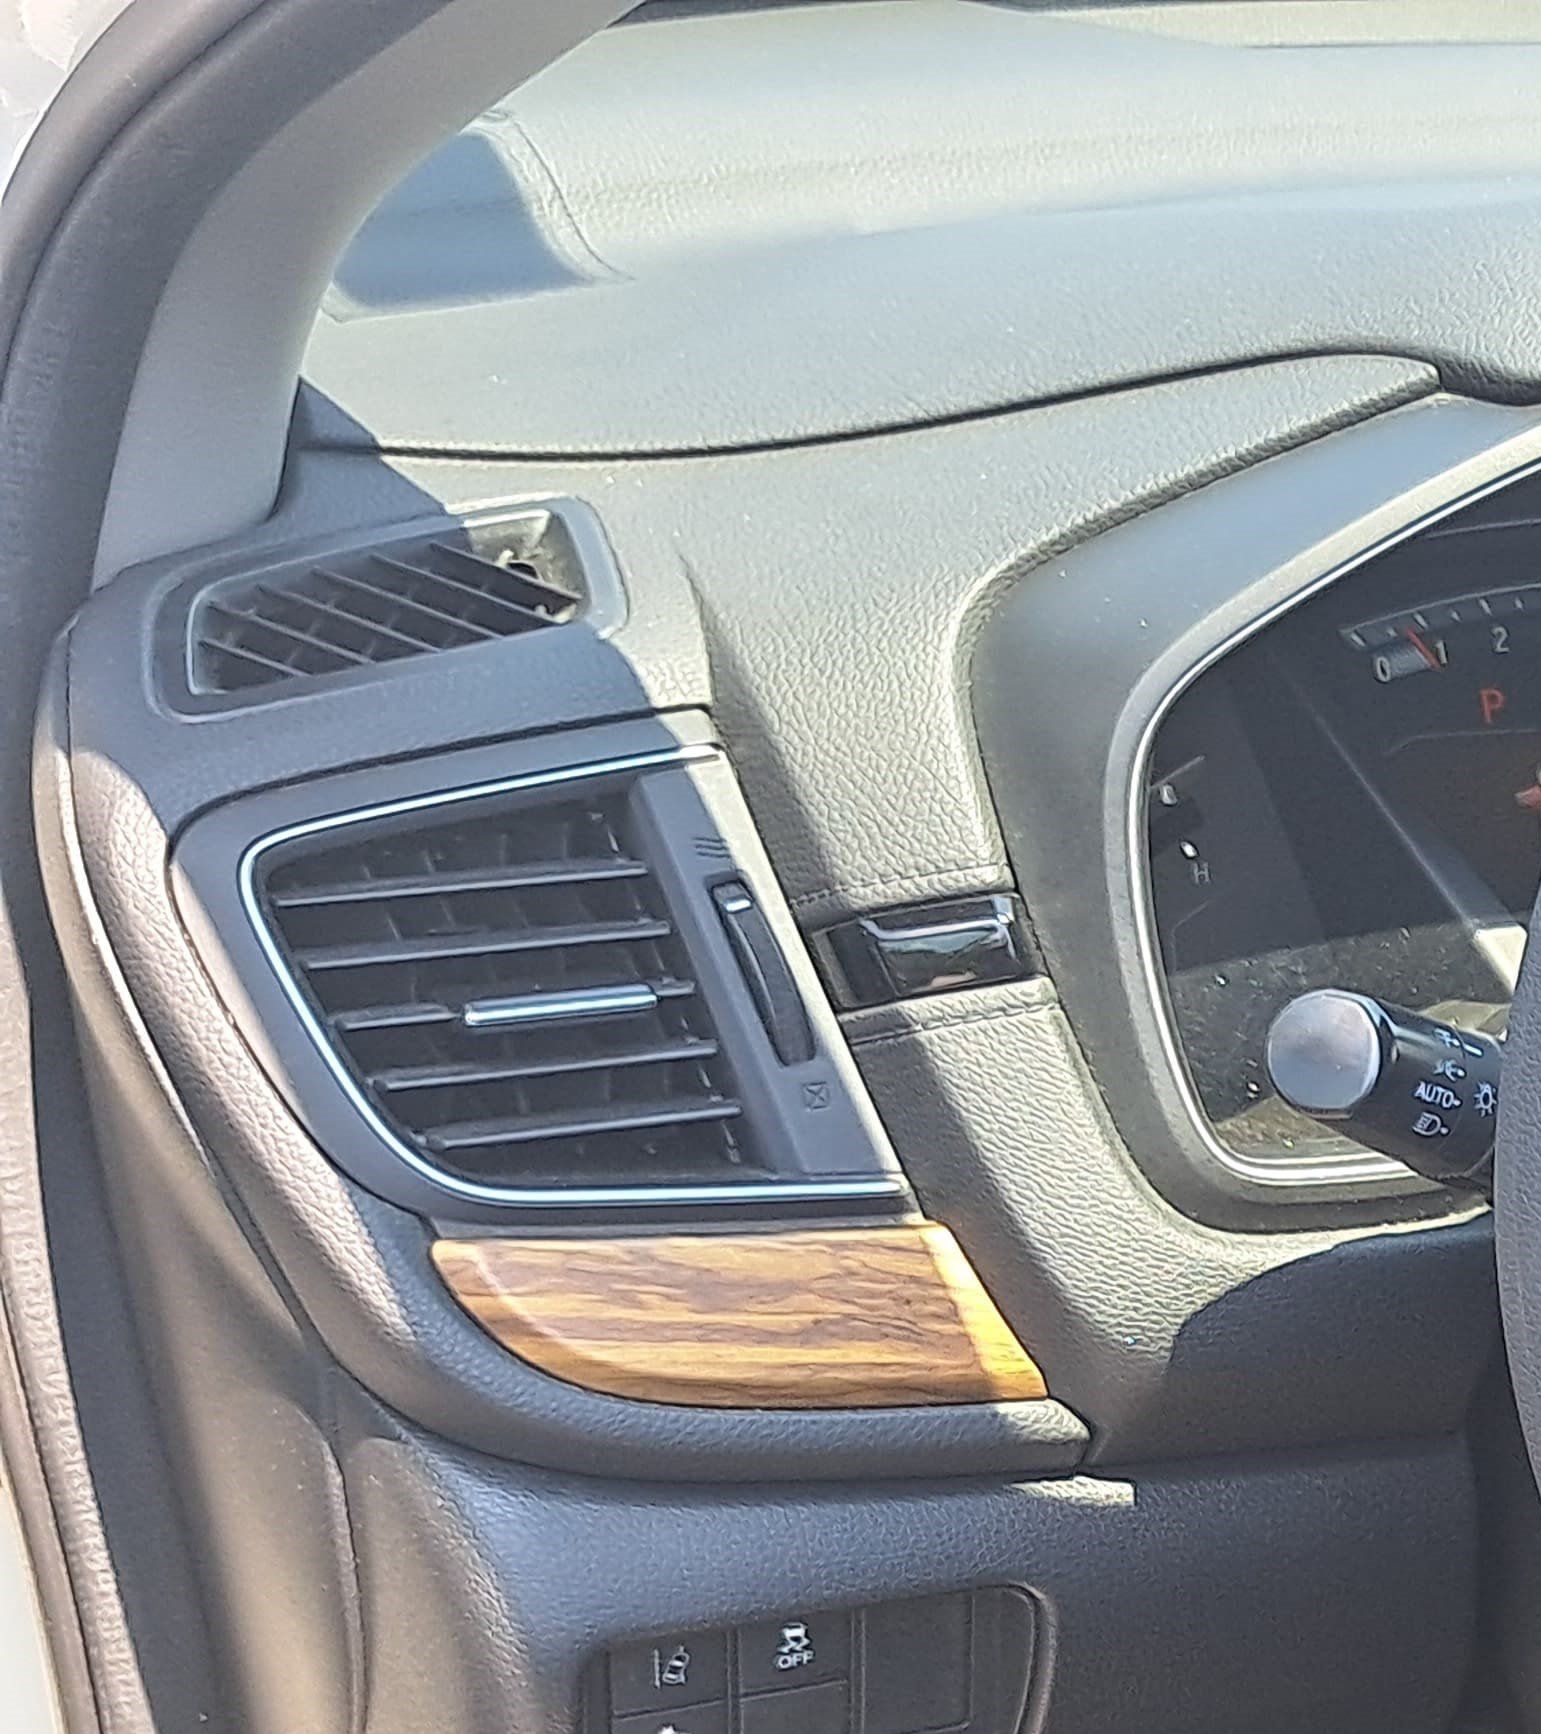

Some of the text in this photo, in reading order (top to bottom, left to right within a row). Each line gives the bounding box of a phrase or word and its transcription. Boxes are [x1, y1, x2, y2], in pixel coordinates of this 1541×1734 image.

[1374, 656, 1392, 683] 0
[1491, 626, 1510, 653] 2
[1480, 687, 1506, 724] P
[1192, 862, 1213, 885] H
[1414, 1080, 1455, 1109] AUTO
[775, 1650, 815, 1672] OFF
